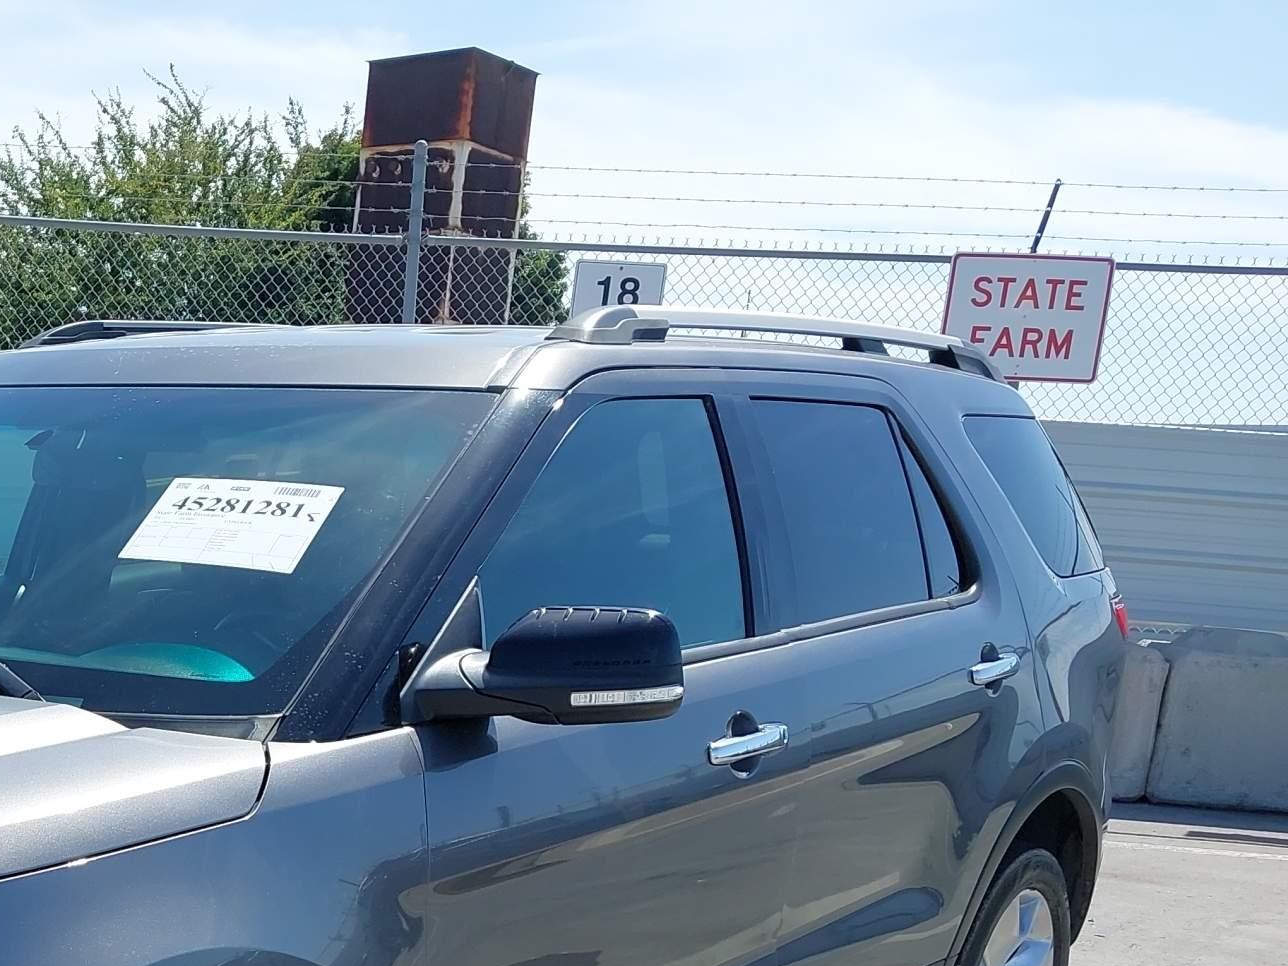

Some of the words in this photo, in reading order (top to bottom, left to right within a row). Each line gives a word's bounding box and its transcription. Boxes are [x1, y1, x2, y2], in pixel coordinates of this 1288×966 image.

[597, 275, 640, 306] 18
[970, 276, 1088, 311] STATE
[970, 325, 1074, 360] FARM
[172, 495, 305, 519] 45281281
